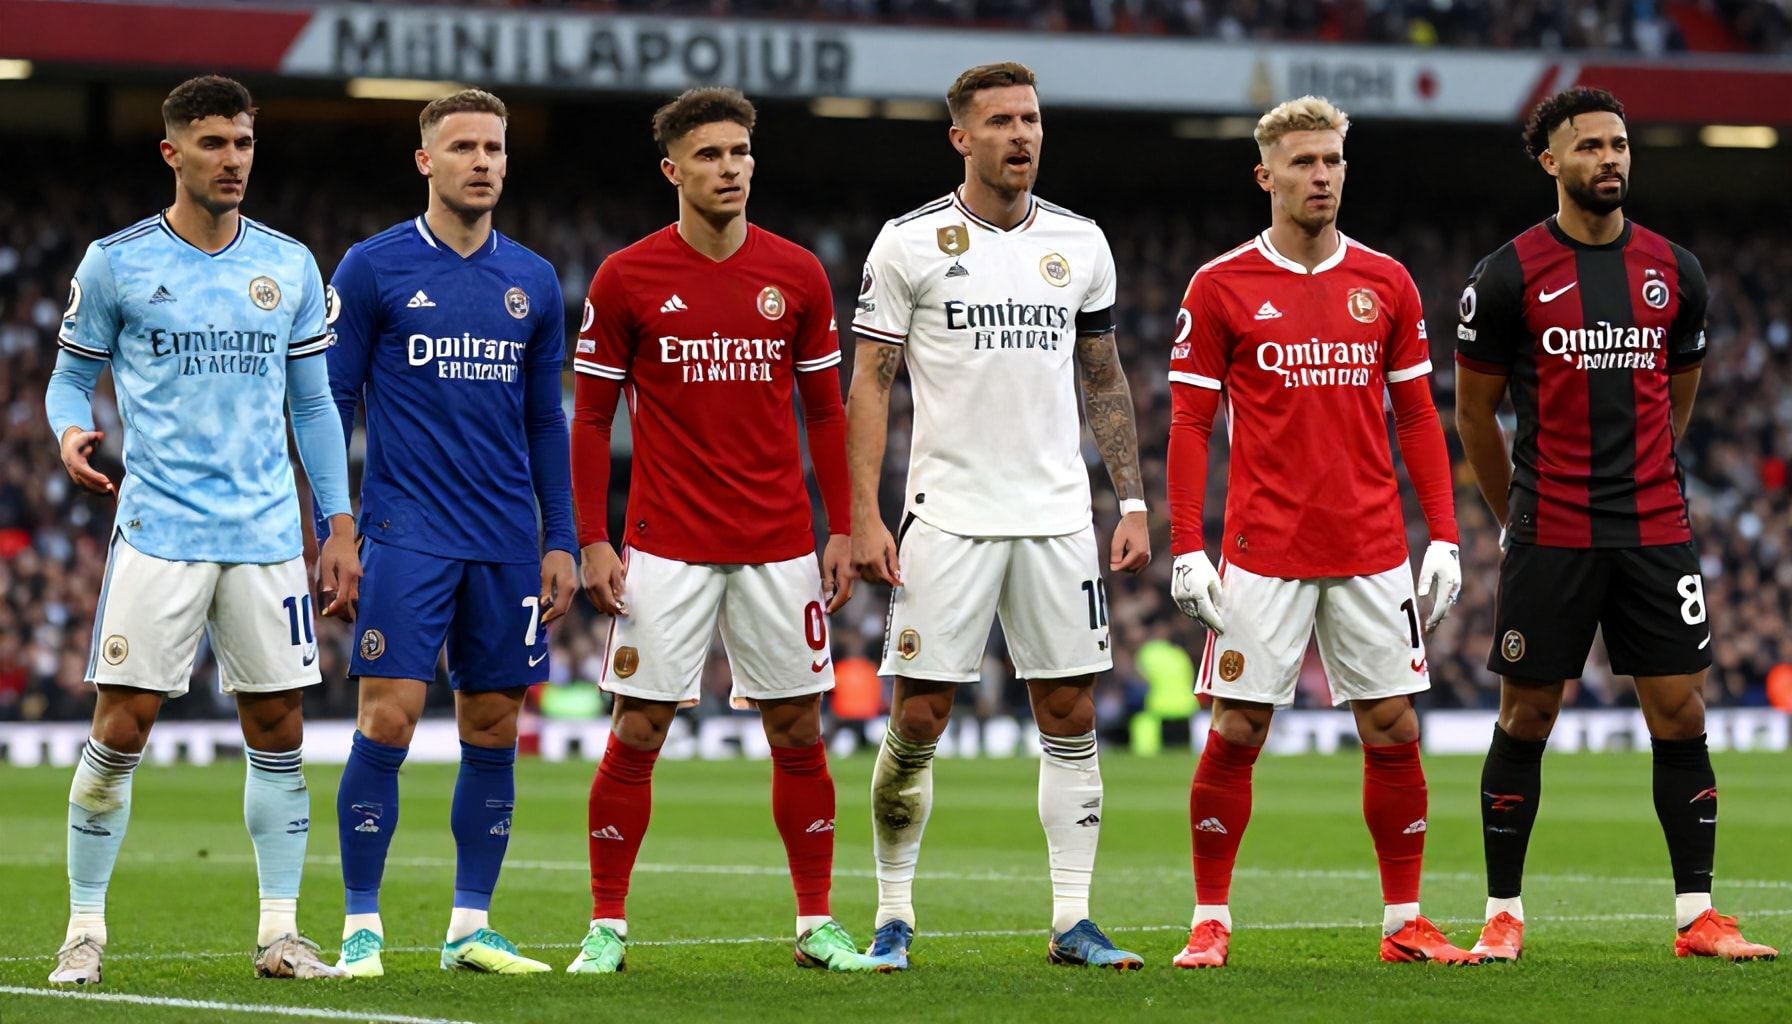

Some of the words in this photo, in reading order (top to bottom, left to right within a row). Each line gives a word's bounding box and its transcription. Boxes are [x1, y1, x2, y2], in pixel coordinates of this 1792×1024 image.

[521, 596, 540, 646] 7
[1399, 598, 1420, 649] 1
[1676, 574, 1706, 625] 8
[803, 600, 827, 651] 0
